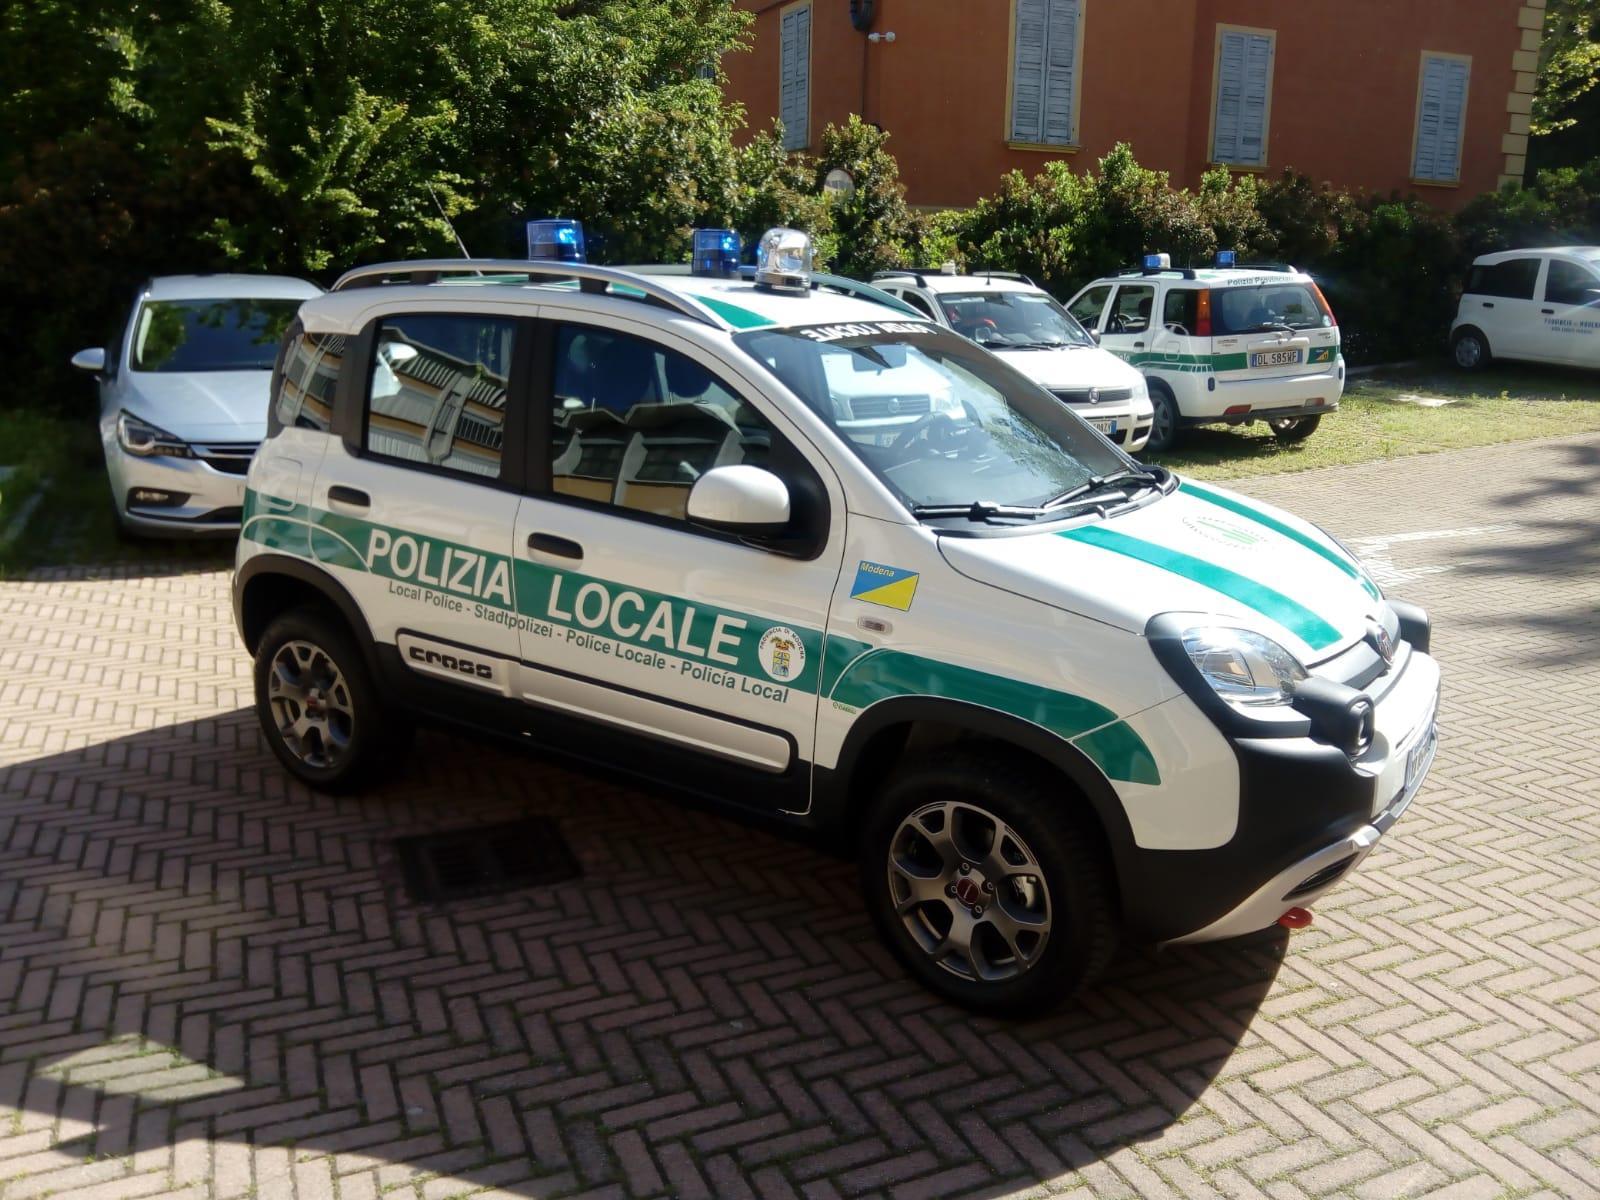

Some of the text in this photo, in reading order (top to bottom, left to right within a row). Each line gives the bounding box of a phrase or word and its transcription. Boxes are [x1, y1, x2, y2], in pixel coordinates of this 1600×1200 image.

[1257, 353, 1268, 365] DL
[367, 528, 748, 665] POLIZIA LOCALE
[860, 562, 895, 577] Modena
[388, 581, 421, 601] Local
[424, 591, 463, 612] Police
[474, 604, 553, 638] Stadtpolizei
[566, 629, 611, 654] Police
[615, 643, 666, 669] Locale
[680, 661, 736, 688] Policía
[741, 677, 789, 703] Local
